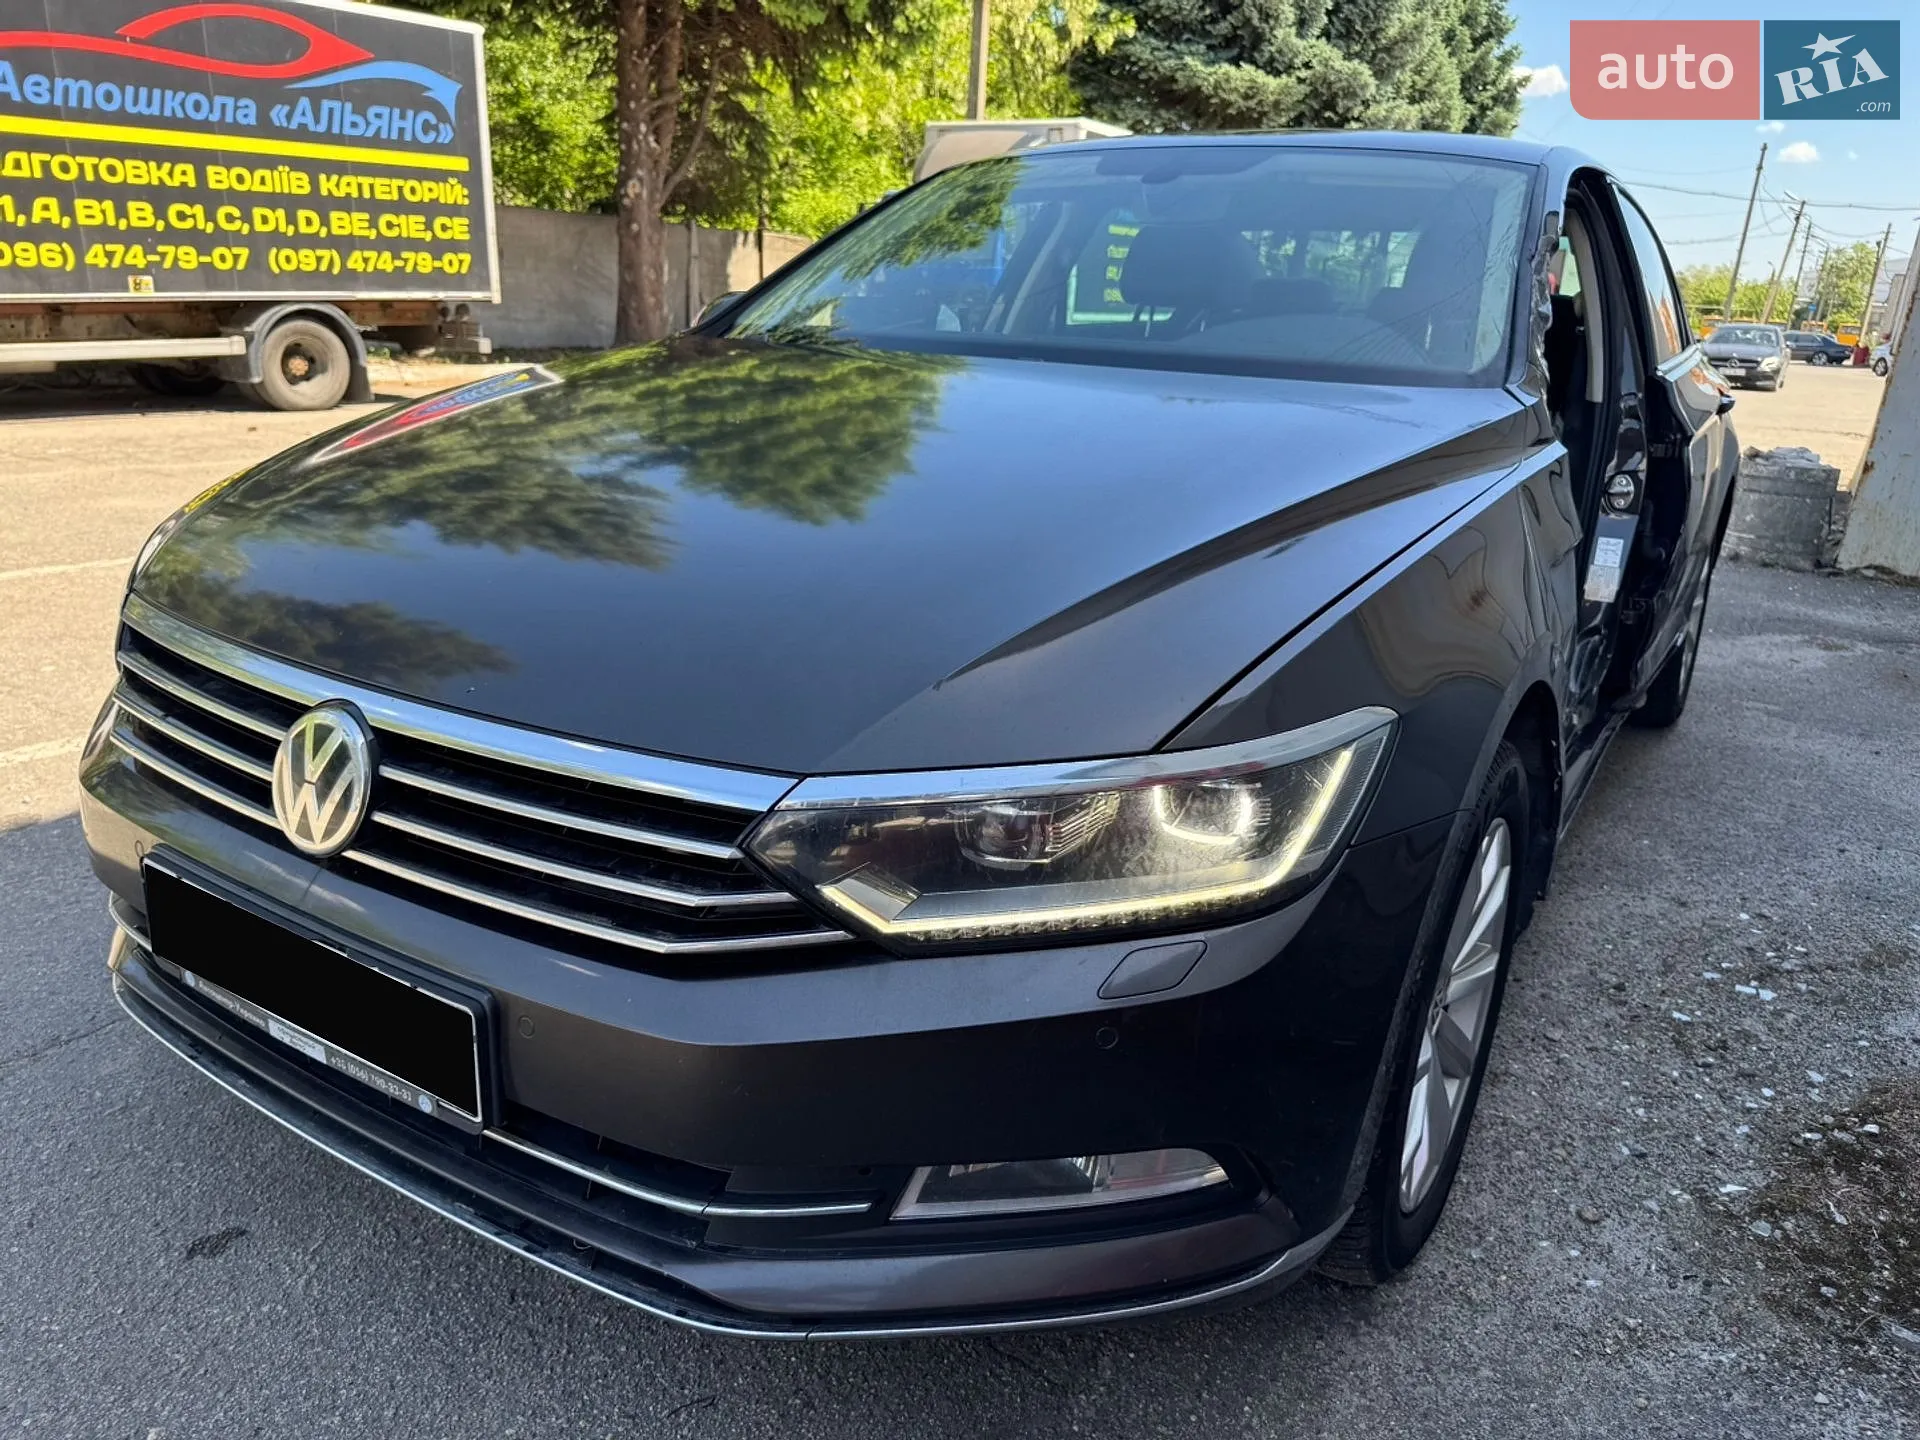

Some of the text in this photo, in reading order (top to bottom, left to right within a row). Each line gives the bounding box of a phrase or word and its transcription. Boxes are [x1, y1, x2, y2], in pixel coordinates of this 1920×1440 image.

[0, 60, 257, 125] Автошкола
[206, 165, 313, 197] ВОДІЇВ
[318, 173, 471, 207] КАТЕГОРІЙ:
[84, 243, 250, 272] 474-79-07
[268, 247, 343, 275] (097)
[345, 249, 473, 276] 474-79-07
